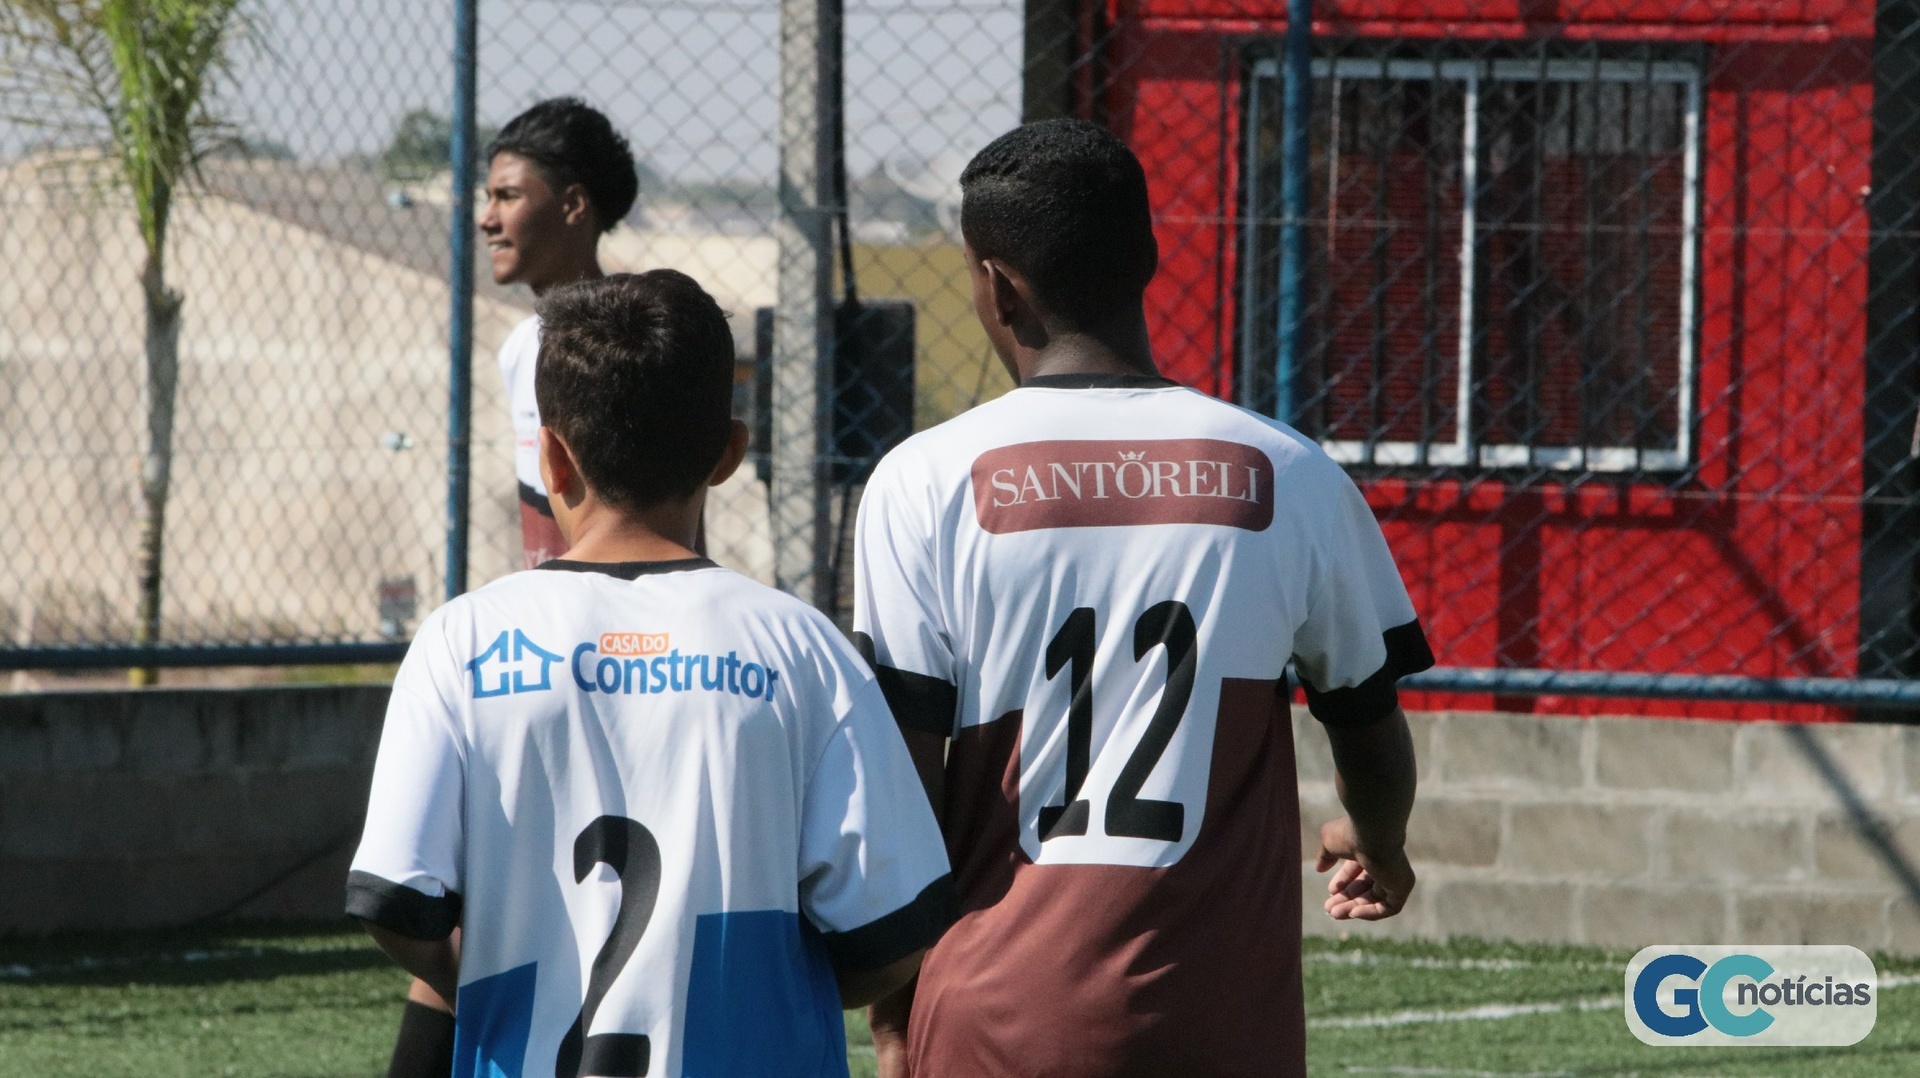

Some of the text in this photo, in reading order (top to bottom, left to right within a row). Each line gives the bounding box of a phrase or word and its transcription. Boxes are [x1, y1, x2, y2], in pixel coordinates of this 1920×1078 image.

[991, 459, 1260, 508] SANTORELI
[571, 642, 778, 702] Construtor
[602, 635, 666, 653] CASA DO
[1038, 600, 1198, 843] 12
[555, 814, 662, 1078] 2
